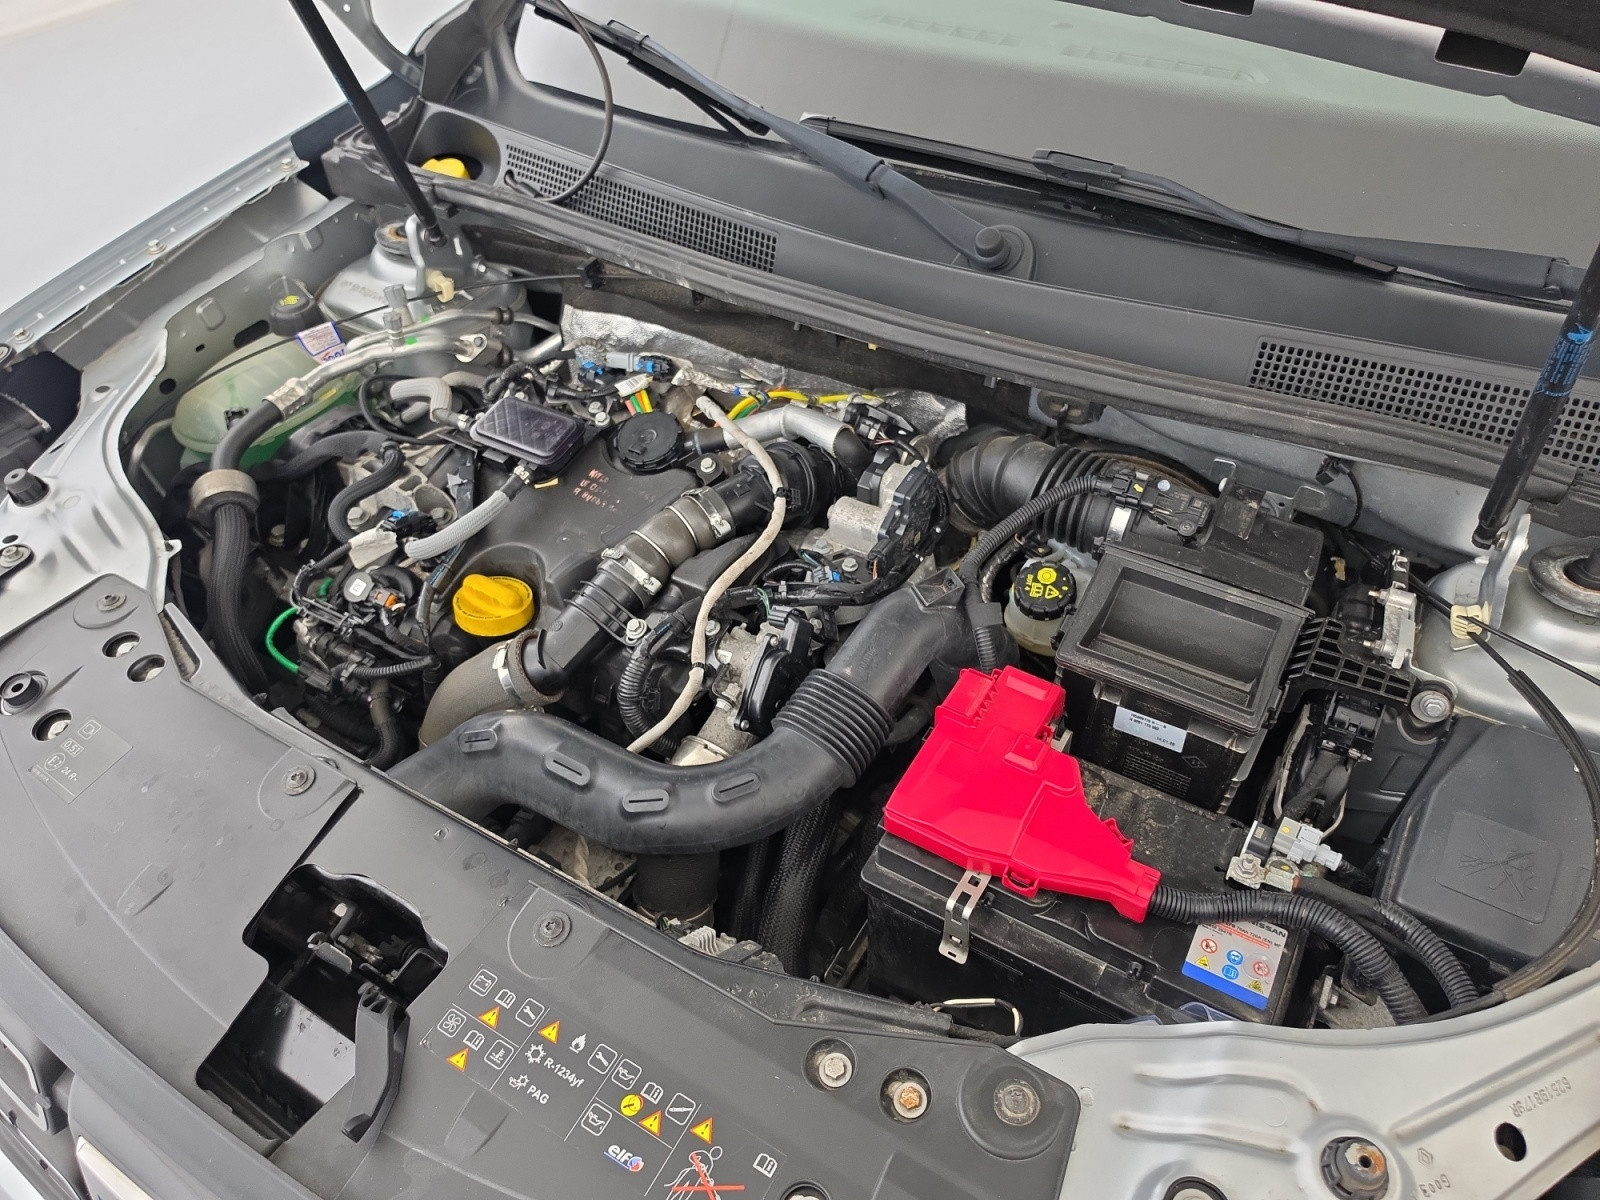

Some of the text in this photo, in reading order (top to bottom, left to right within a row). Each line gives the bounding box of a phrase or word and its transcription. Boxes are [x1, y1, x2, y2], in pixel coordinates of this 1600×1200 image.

[543, 1058, 585, 1088] R-1234yf
[526, 1084, 550, 1105] PAG
[607, 1144, 632, 1163] elf
